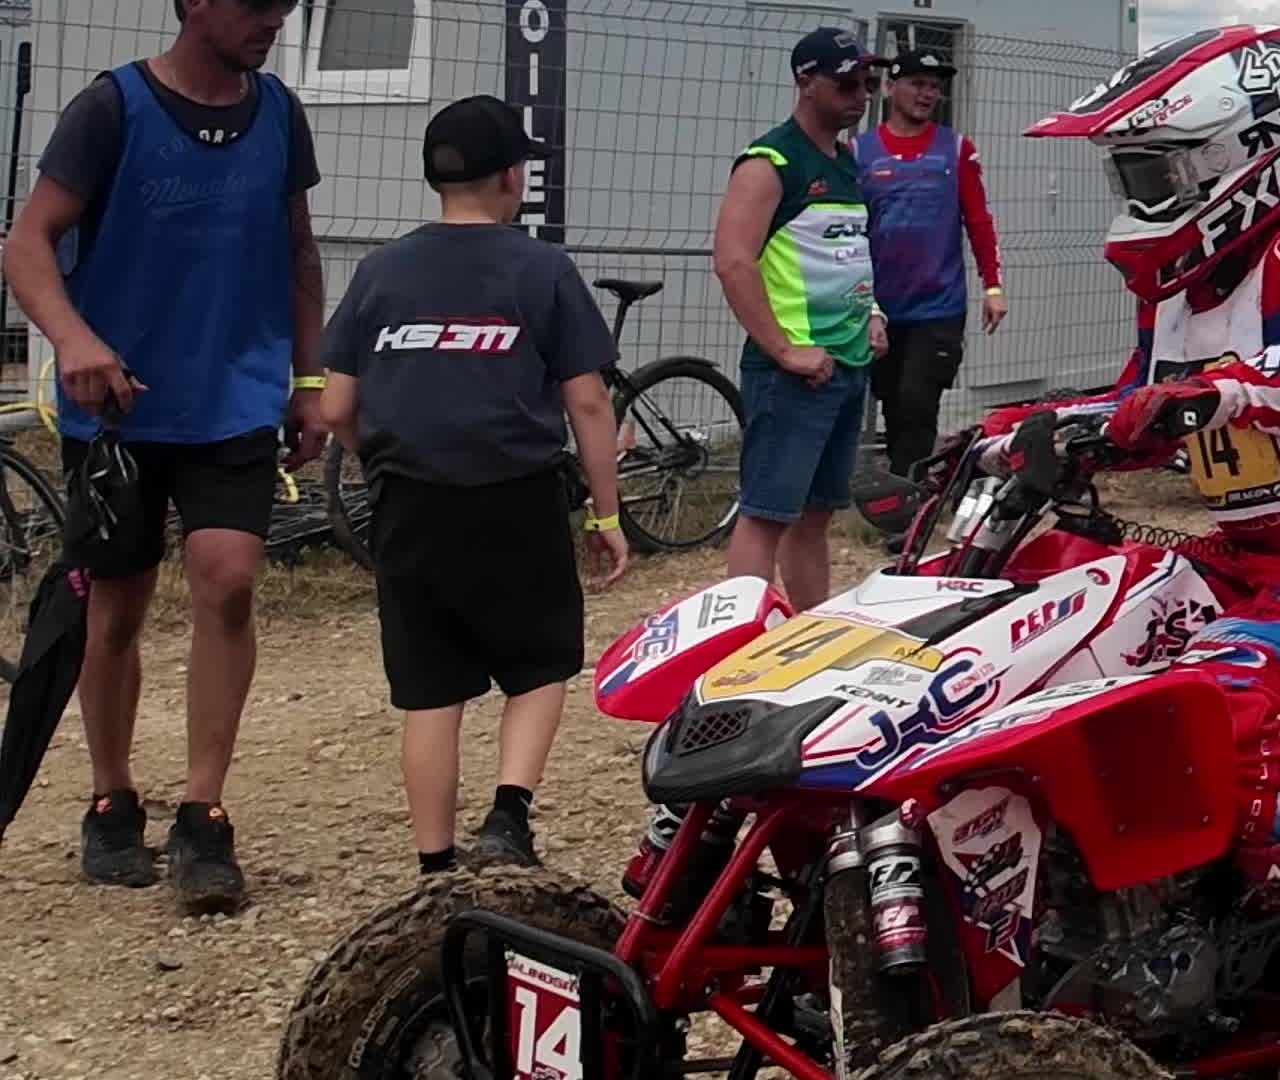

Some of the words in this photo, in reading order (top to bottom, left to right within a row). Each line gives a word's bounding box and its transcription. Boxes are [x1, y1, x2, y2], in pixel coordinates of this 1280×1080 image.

[1197, 425, 1241, 479] 14
[936, 579, 985, 593] HRC
[747, 620, 856, 667] 14
[834, 683, 912, 709] KENNY
[515, 985, 583, 1080] 14
